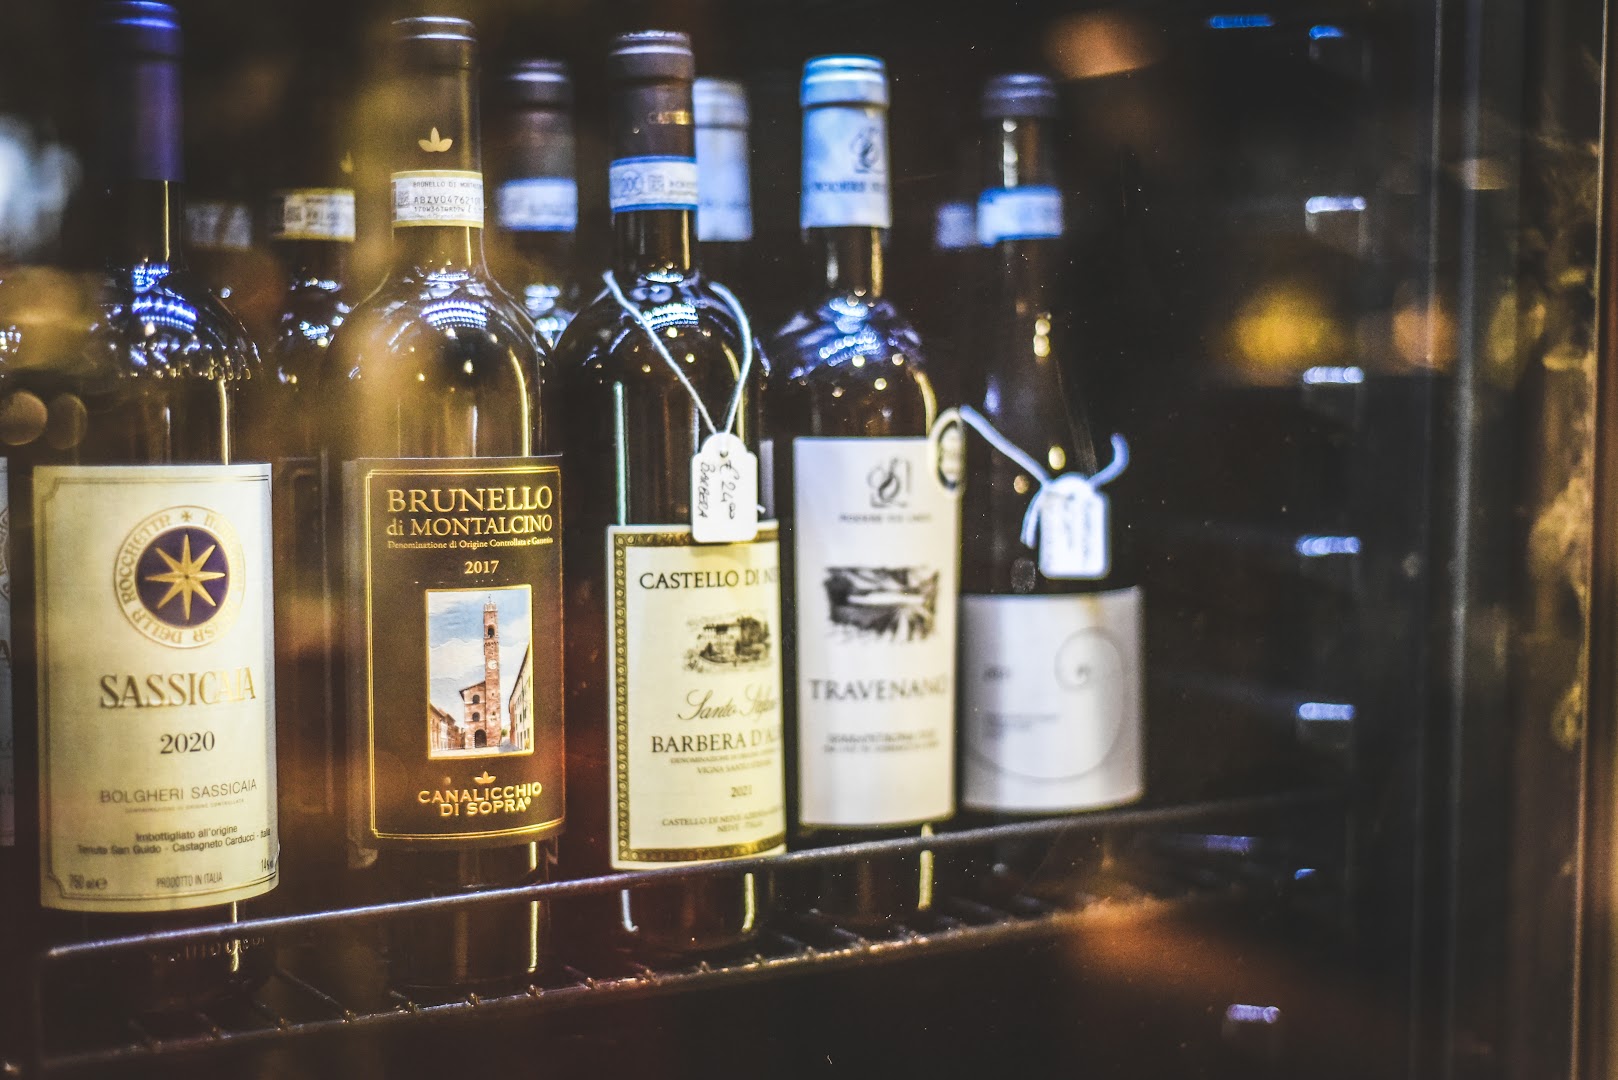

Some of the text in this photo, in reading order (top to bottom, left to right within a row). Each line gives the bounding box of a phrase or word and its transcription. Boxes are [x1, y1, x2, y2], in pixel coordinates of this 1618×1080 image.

[386, 485, 553, 513] BRUNELLO
[386, 514, 553, 537] di MONTALCINO
[449, 539, 458, 549] di
[459, 538, 489, 551] Origine
[489, 537, 527, 548] Controllata
[464, 560, 500, 575] 2017
[639, 570, 740, 590] CASTELLO
[745, 568, 760, 587] DI
[99, 667, 257, 710] SASSICAIA
[159, 730, 216, 755] 2020
[651, 731, 747, 754] BARBERA
[100, 778, 258, 804] BOLGHERI SASSICAIA
[417, 782, 543, 804] CANALICCHIO
[440, 803, 460, 817] DI
[661, 816, 707, 827] CASTELLO
[135, 825, 238, 843] Imbottigliato all'origine
[172, 838, 223, 853] Castagneto
[225, 831, 255, 847] Carducci
[156, 871, 223, 889] PRODOTTO IN ITALIA
